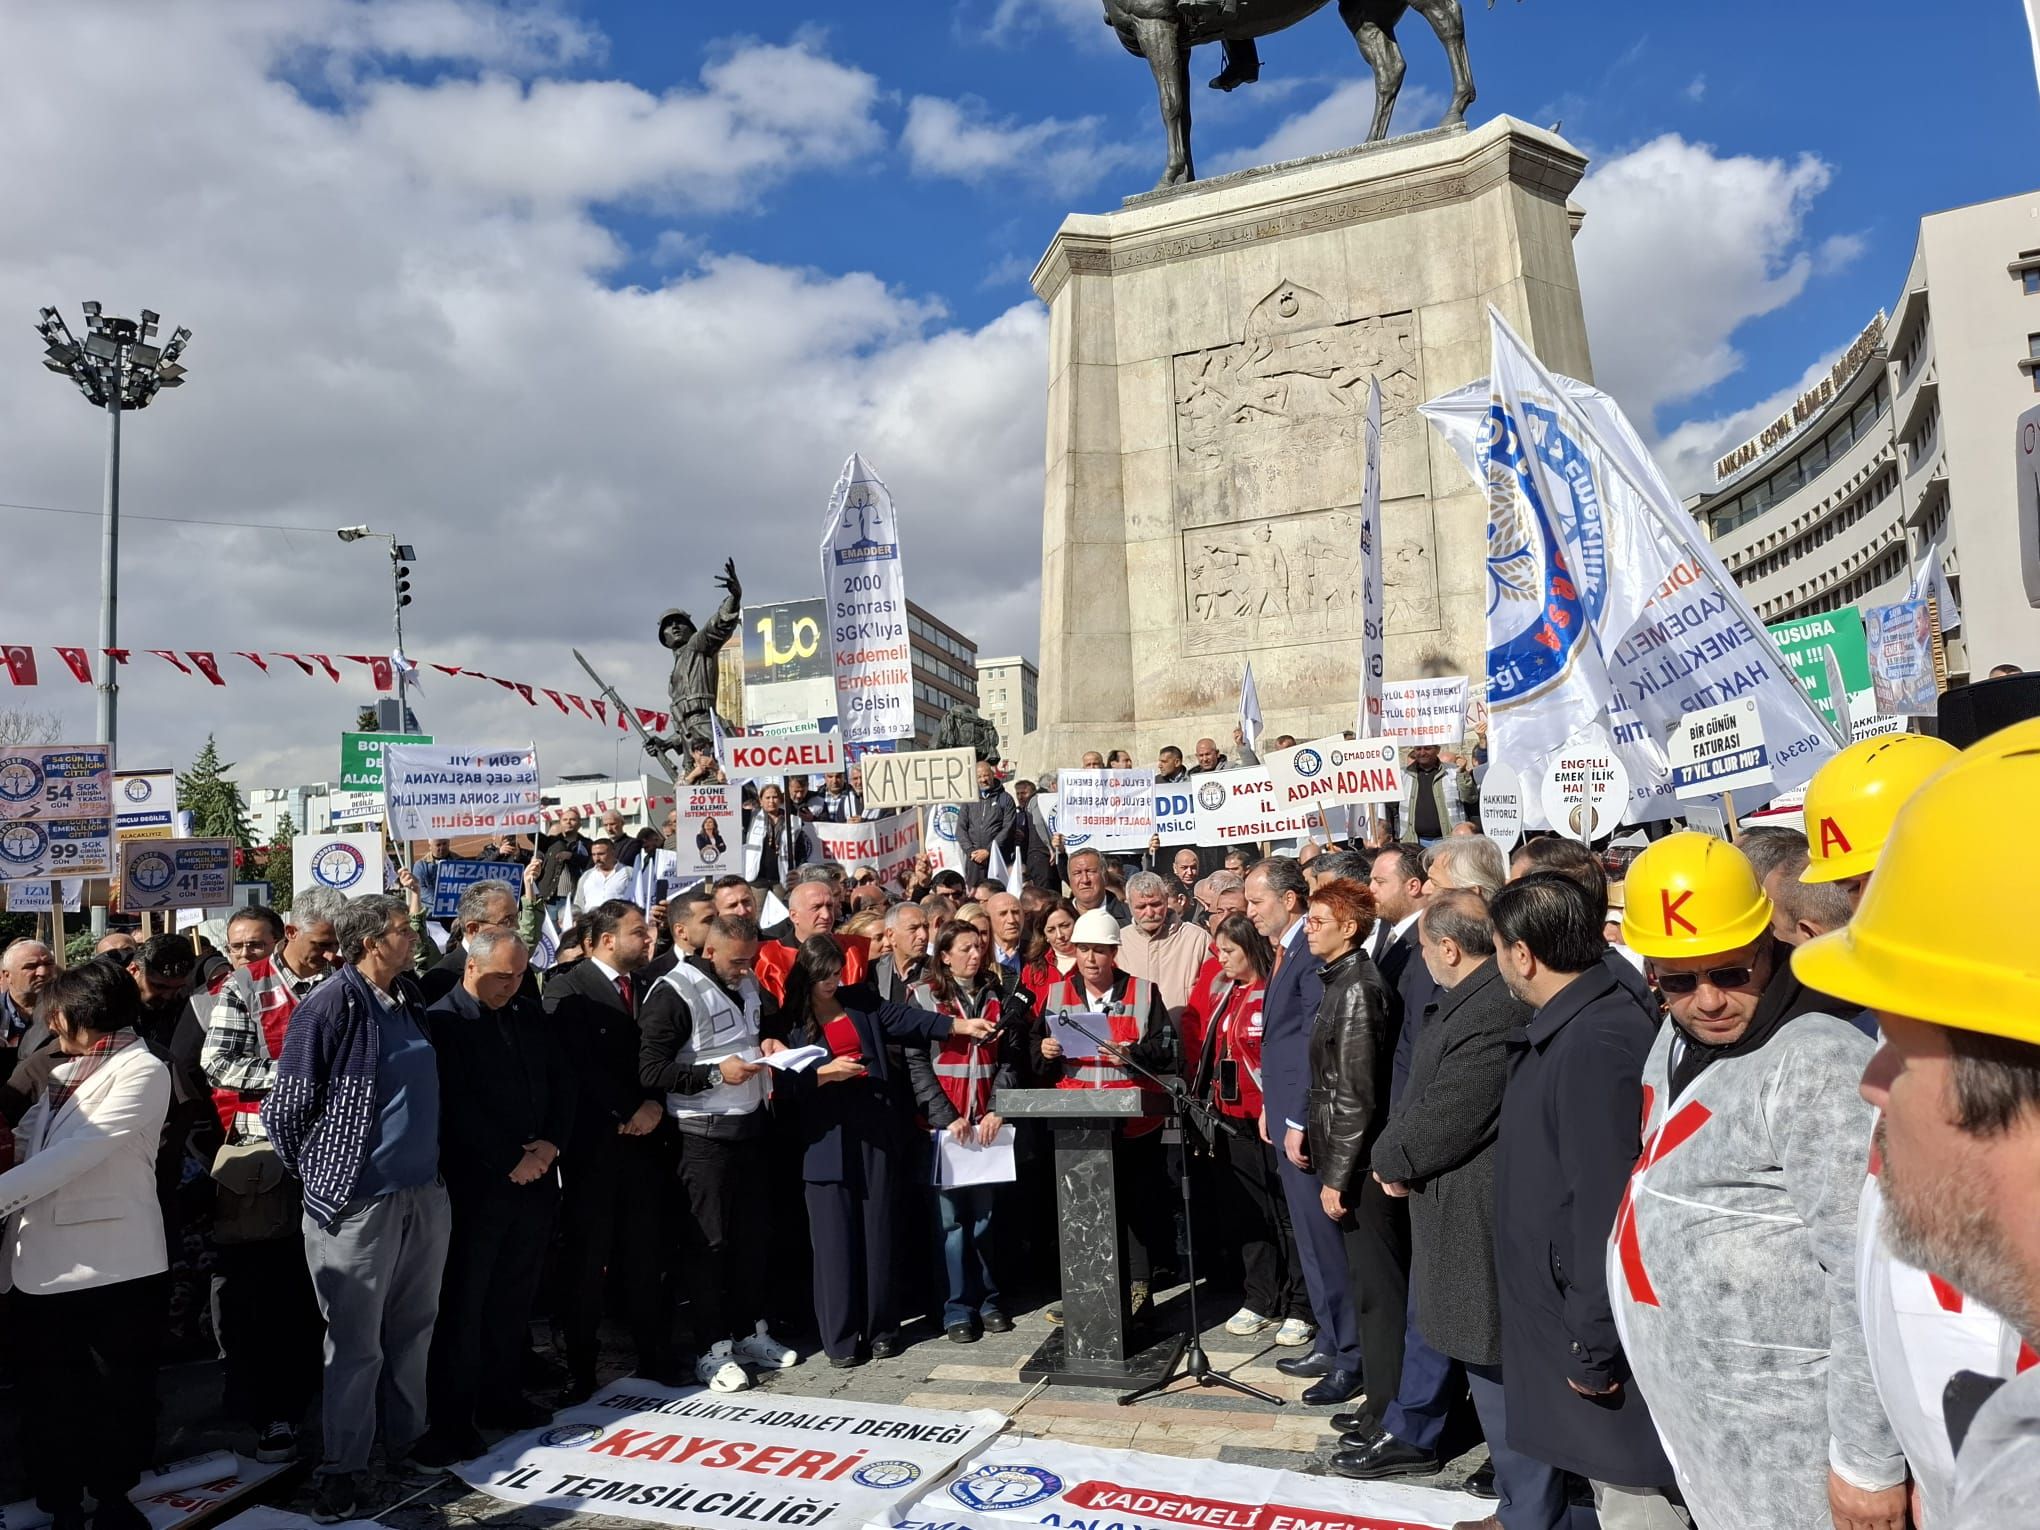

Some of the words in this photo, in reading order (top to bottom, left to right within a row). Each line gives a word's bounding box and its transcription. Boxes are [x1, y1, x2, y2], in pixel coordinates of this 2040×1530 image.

[1716, 438, 1759, 481] ANKARA
[840, 545, 892, 560] EMADDER
[843, 574, 882, 594] 2000
[836, 600, 897, 618] Sonrası
[835, 621, 903, 644] SGK'lıya
[835, 643, 908, 667] Kademeli
[838, 670, 909, 692] Emeklilik
[1404, 689, 1415, 700] 43
[1415, 688, 1431, 699] YAŞ
[1432, 684, 1462, 697] EMEKLİ
[851, 693, 901, 713] Gelsin
[1405, 706, 1416, 718] 60
[1417, 705, 1432, 718] YAŞ
[1432, 703, 1463, 716] EMEKLİ
[765, 723, 818, 737] 2000'LERİN
[843, 726, 870, 738] 0(534)
[888, 725, 898, 735] 19
[899, 723, 911, 734] 32
[1382, 727, 1410, 737] DALET
[1411, 725, 1446, 736] NEREDE
[1689, 724, 1706, 740] BİR
[1706, 713, 1737, 733] GÜNÜN
[733, 739, 835, 768] KOCAELİ
[1693, 732, 1741, 759] FATURASI
[64, 754, 84, 763] GÜN
[85, 754, 99, 762] İLE
[1680, 767, 1693, 783] 17
[1694, 763, 1712, 780] YIL
[1711, 753, 1739, 776] OLUR
[1739, 749, 1761, 769] MU?
[863, 754, 974, 805] KAYSERİ
[1337, 767, 1398, 795] ADANA
[1554, 769, 1615, 782] EMEKİLİK
[46, 785, 74, 802] 54
[699, 787, 726, 796] GÜNE
[1287, 777, 1333, 802] ADAN
[50, 801, 70, 809] GÜN
[689, 796, 707, 805] 20
[708, 795, 729, 805] YIL
[1260, 799, 1276, 813] İL
[1483, 795, 1517, 805] HAKKIMIZI
[117, 814, 139, 824] ORÇLU
[1483, 808, 1518, 819] İSTİYORUZ
[120, 831, 163, 839] ALACAKLIYIZ
[1216, 815, 1324, 839] TEMSİLCİLİĞİ
[1820, 817, 1853, 859] A
[50, 843, 78, 859] 99
[440, 863, 520, 880] MEZARDA
[879, 847, 945, 886] DERNĞİ
[176, 874, 198, 890] 41
[1659, 888, 1698, 938] K
[598, 1393, 750, 1424] EMEKLİLİKTE
[751, 1406, 854, 1434] ADALET
[850, 1416, 977, 1446] DERNEĞİ
[587, 1427, 871, 1483] KAYSERİ
[494, 1466, 531, 1492] İL
[546, 1473, 840, 1528] TEMSİLCİLİĞİ
[1088, 1490, 1262, 1529] KADEMELİ
